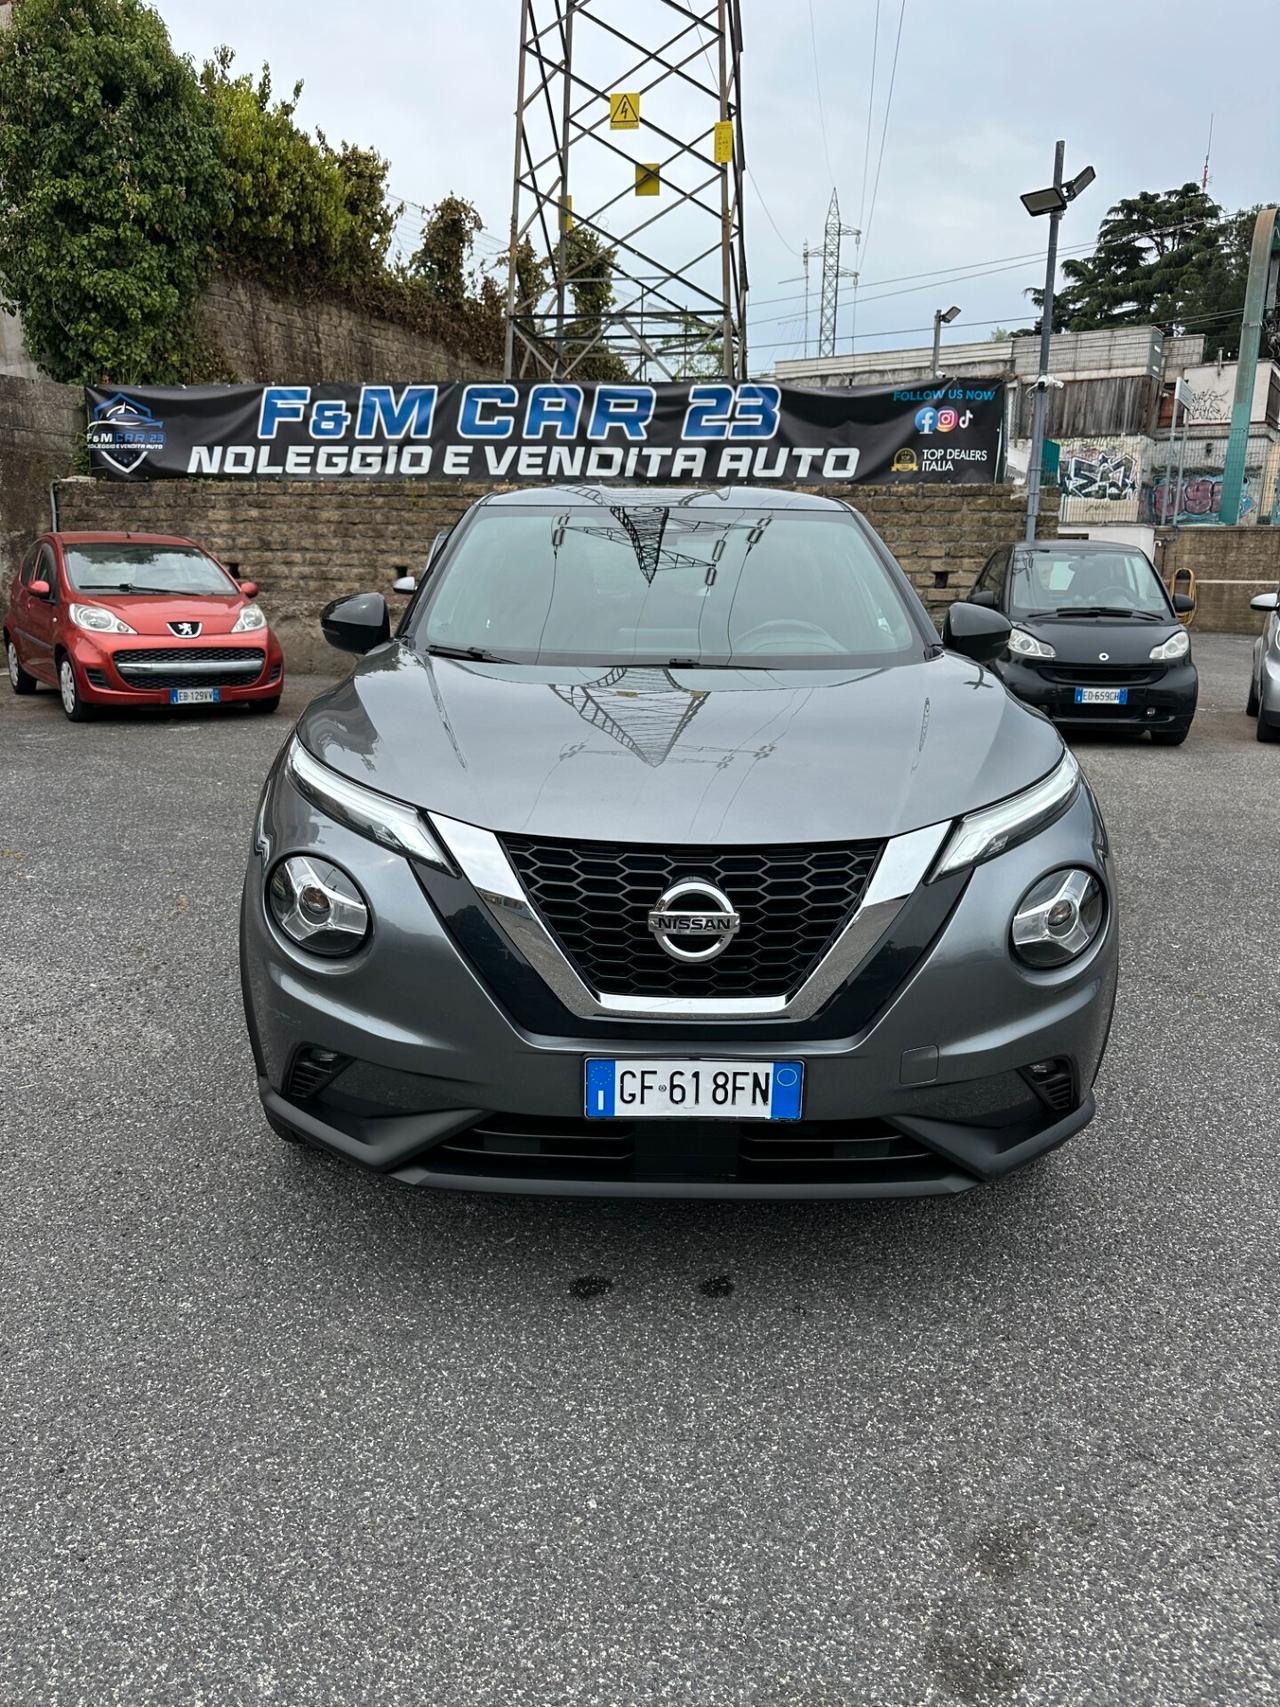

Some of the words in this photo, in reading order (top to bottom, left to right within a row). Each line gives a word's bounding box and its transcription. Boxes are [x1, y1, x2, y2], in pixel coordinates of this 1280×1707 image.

[893, 390, 945, 401] FOLLOW
[948, 389, 963, 400] US
[966, 390, 995, 400] NOW
[257, 385, 438, 440] F&M
[456, 384, 657, 440] CAR
[681, 384, 781, 441] 23
[115, 432, 145, 443] CAR
[149, 432, 164, 443] 23
[922, 449, 944, 460] TOP
[946, 449, 988, 461] DEALERS
[187, 445, 433, 475] NOLEGGIO
[442, 445, 474, 475] E
[484, 446, 707, 478] VENDITA
[718, 446, 861, 478] AUTO
[922, 460, 954, 471] ITALIA
[658, 918, 731, 930] NISSAN
